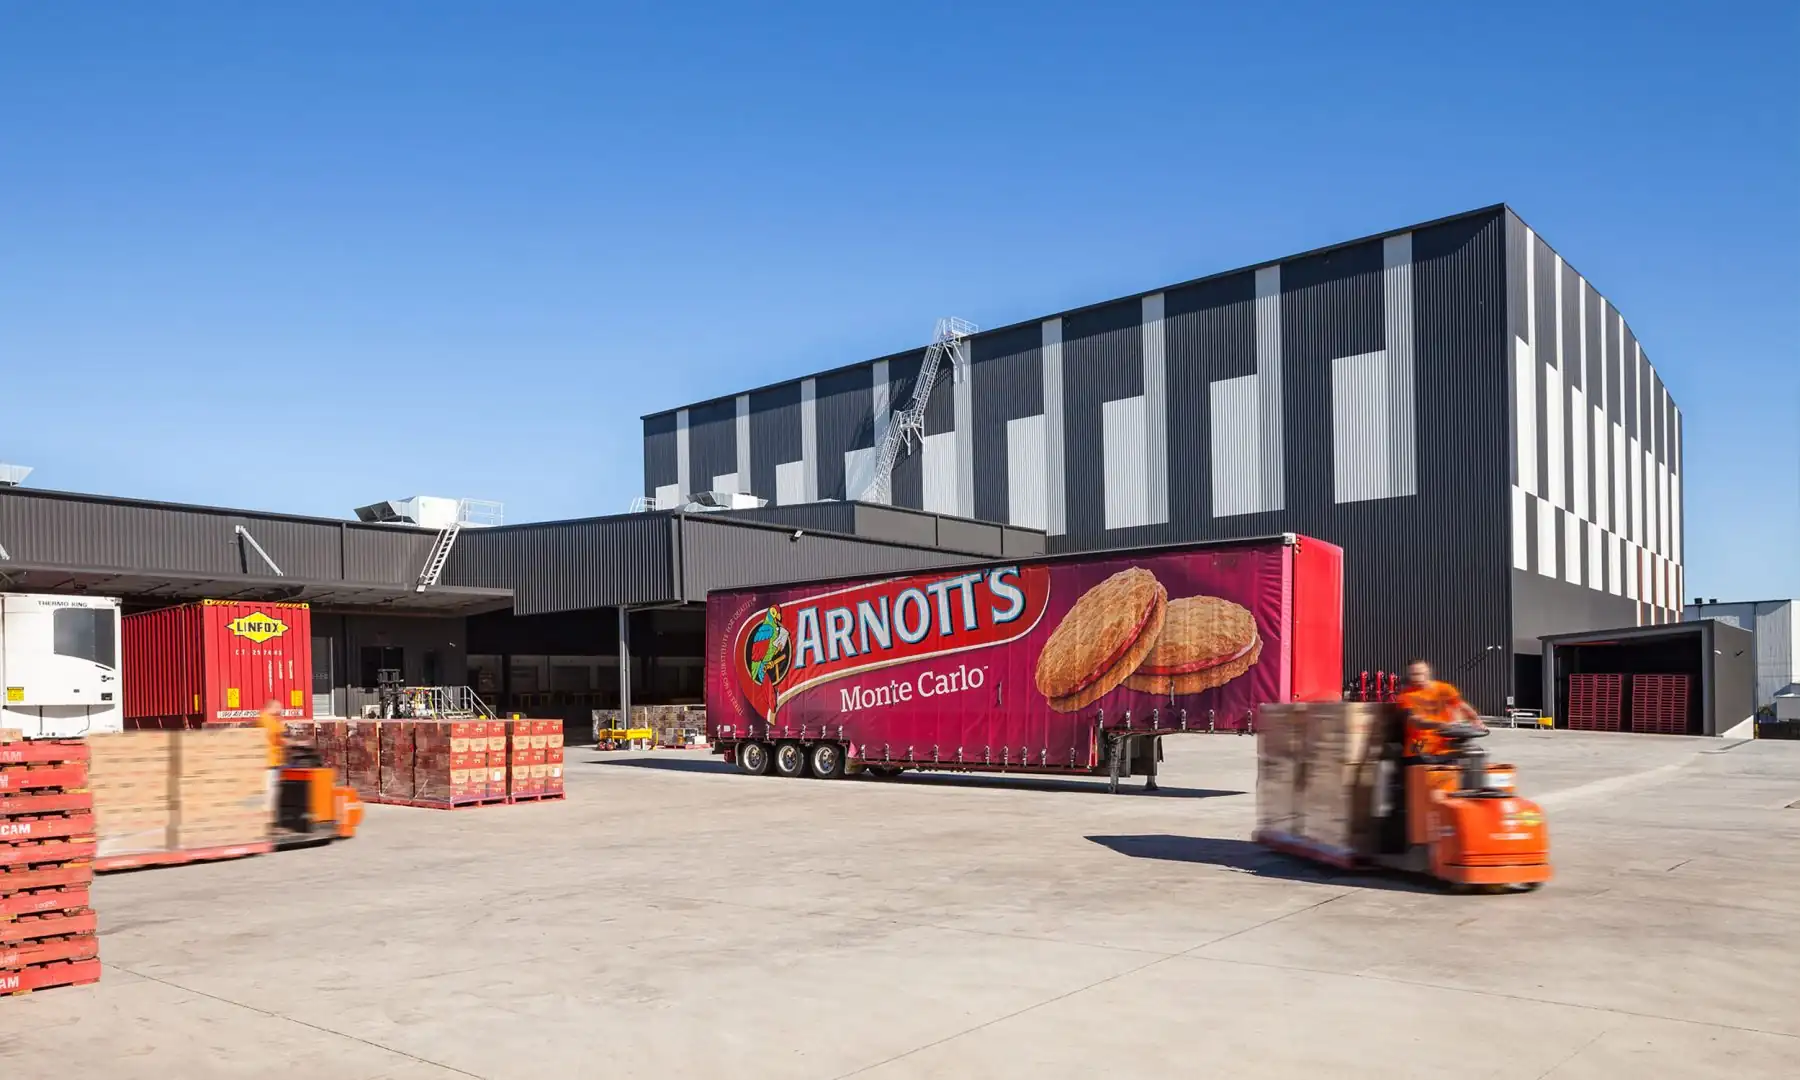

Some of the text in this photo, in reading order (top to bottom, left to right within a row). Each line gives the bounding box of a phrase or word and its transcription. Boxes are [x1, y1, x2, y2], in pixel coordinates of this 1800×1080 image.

[236, 621, 280, 633] LINFOX
[794, 565, 1026, 669] ARNOTT'S
[840, 680, 913, 713] Monte
